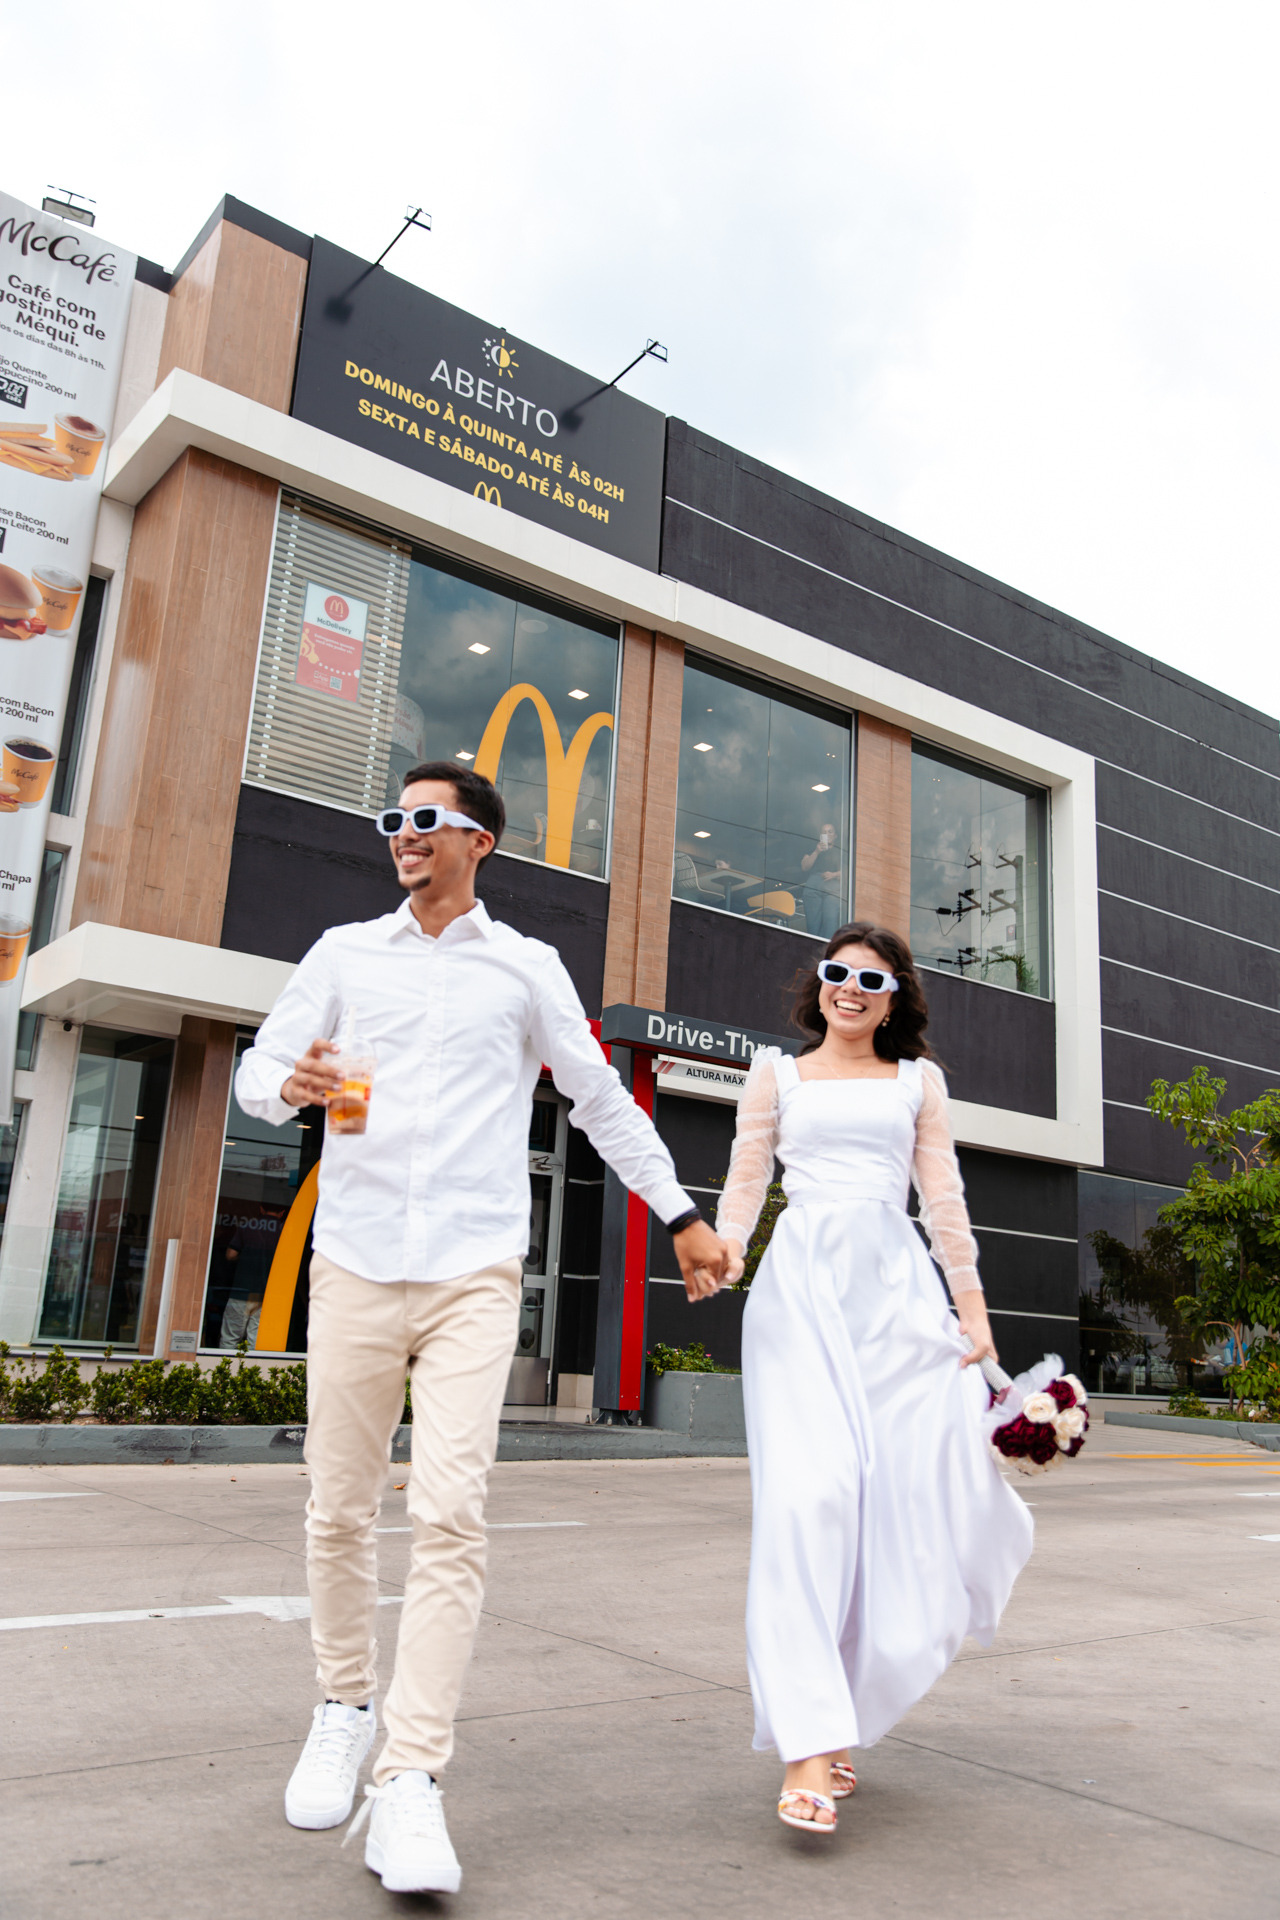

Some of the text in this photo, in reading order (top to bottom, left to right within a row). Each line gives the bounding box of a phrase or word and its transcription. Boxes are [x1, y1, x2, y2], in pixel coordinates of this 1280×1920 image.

[0, 217, 117, 285] McCafé
[8, 274, 96, 321] Café com
[16, 311, 79, 347] Méqui.
[83, 323, 106, 341] de
[13, 328, 24, 338] os
[26, 333, 45, 346] dias
[47, 341, 63, 353] das
[64, 348, 76, 359] 8h
[11, 361, 47, 380] Quente
[45, 382, 62, 395] 200
[64, 390, 77, 400] ml
[430, 359, 559, 437] ABERTO
[345, 360, 625, 502] DOMINGO À QUINTA ATÉ ÀS 02H
[358, 398, 610, 523] SEXTA E SÁBADO ATÉ ÀS 04H
[16, 511, 46, 528] Bacon
[11, 519, 35, 533] Leite
[37, 528, 55, 540] 200
[56, 536, 69, 545] ml
[5, 706, 24, 719] 200
[25, 714, 38, 723] ml
[23, 701, 54, 717] Bacon
[0, 869, 31, 884] Chapa
[2, 882, 15, 891] ml
[647, 1014, 771, 1059] Drive-Th
[686, 1067, 721, 1082] ALTURA
